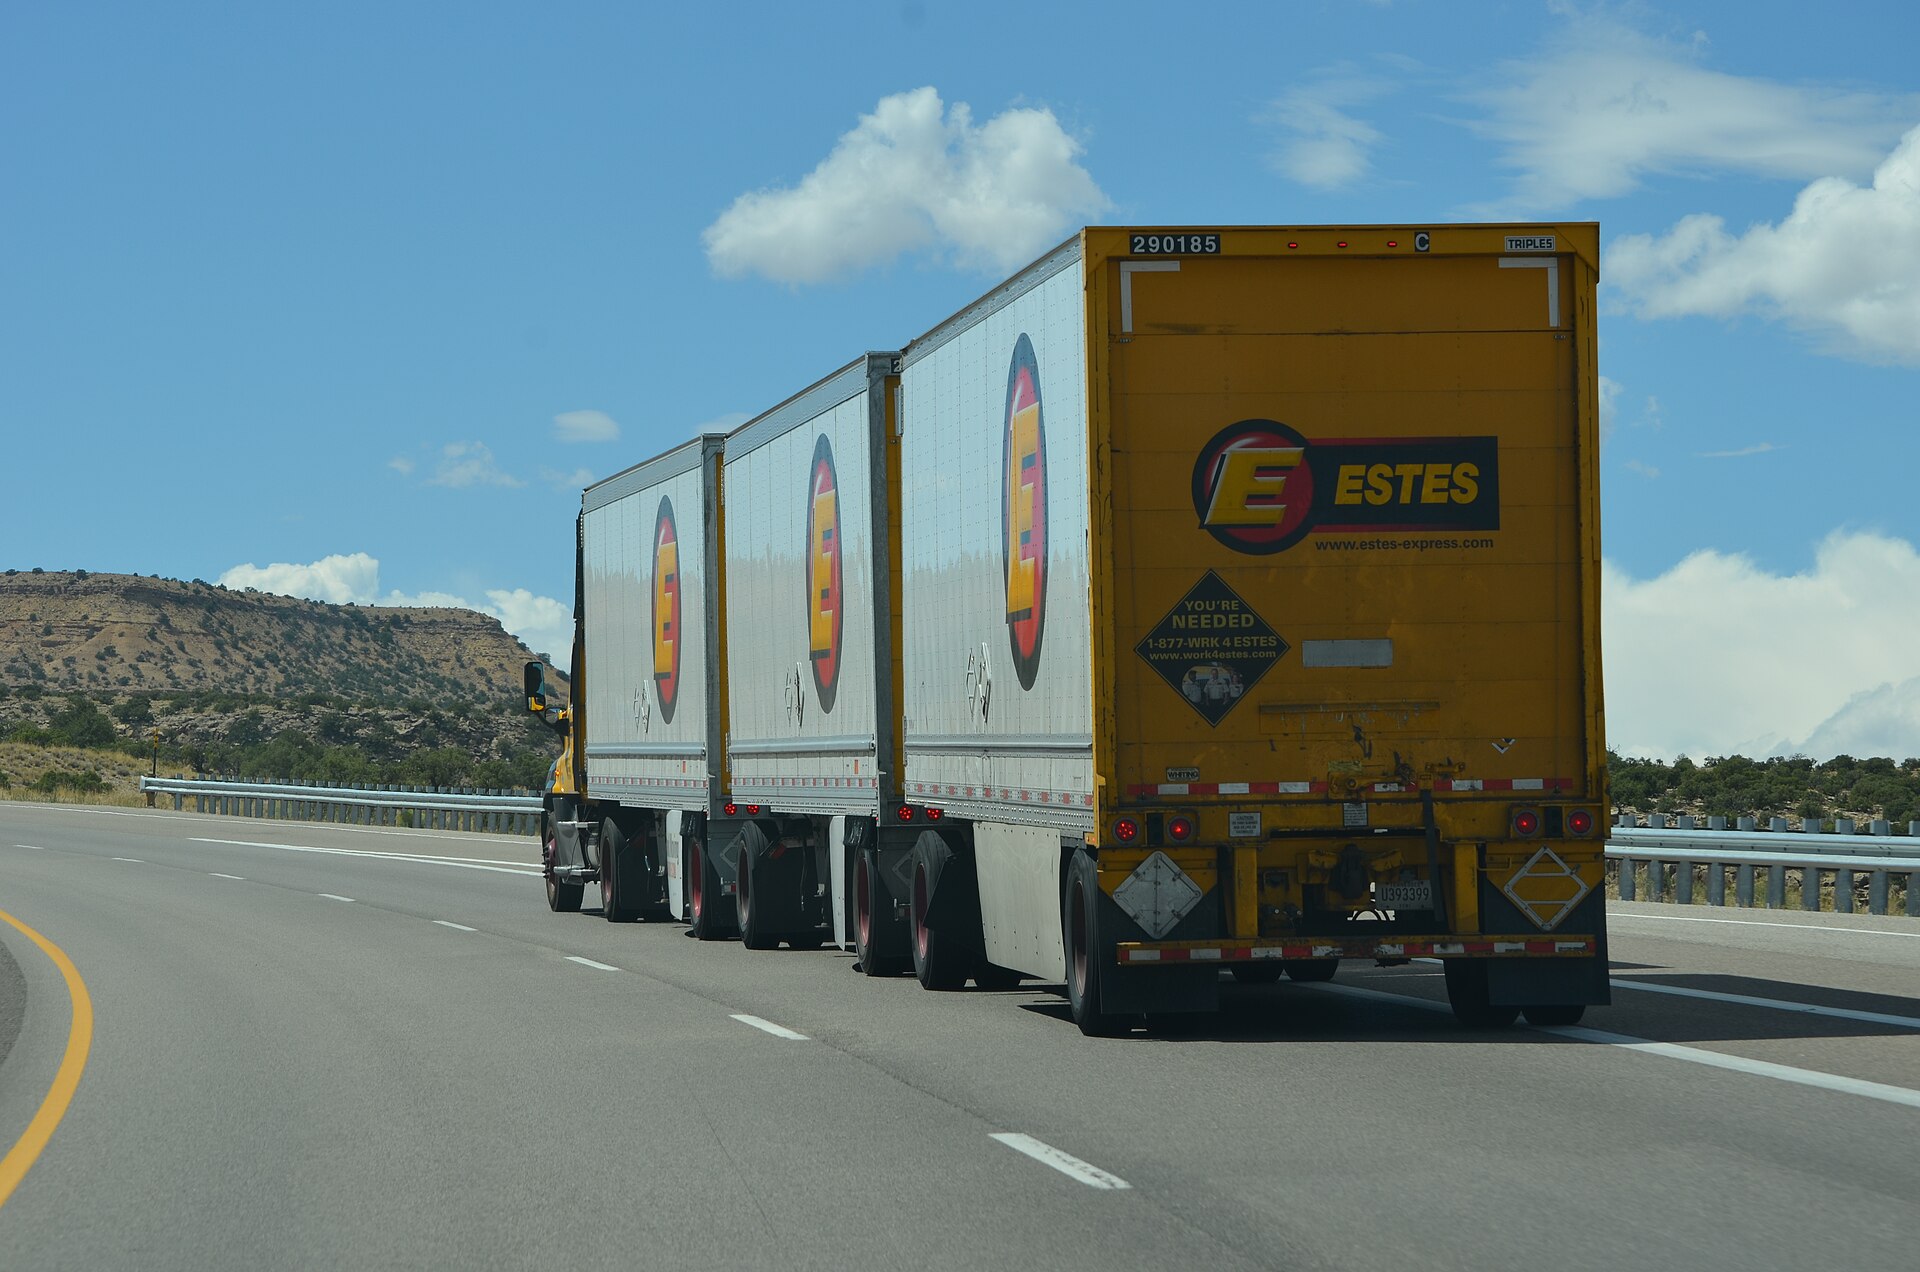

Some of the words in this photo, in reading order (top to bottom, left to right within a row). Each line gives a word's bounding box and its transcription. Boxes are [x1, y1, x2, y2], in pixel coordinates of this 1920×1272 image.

[1133, 235, 1217, 253] 290185
[1415, 233, 1429, 251] C
[1507, 238, 1553, 249] TRIPLES
[1202, 446, 1304, 527] E
[1334, 462, 1480, 506] ESTES
[1007, 402, 1040, 618] E
[1315, 538, 1494, 552] www.estes-express.com
[811, 489, 836, 655] E
[655, 541, 677, 676] E
[1184, 600, 1240, 611] YOU'RE
[1172, 614, 1255, 629] NEEDED
[1147, 637, 1220, 649] 1-877-WRK
[1222, 637, 1232, 647] 4
[1233, 636, 1278, 647] ESTES
[1149, 650, 1277, 660] www.work4estes.com
[1381, 887, 1429, 901] U393399
